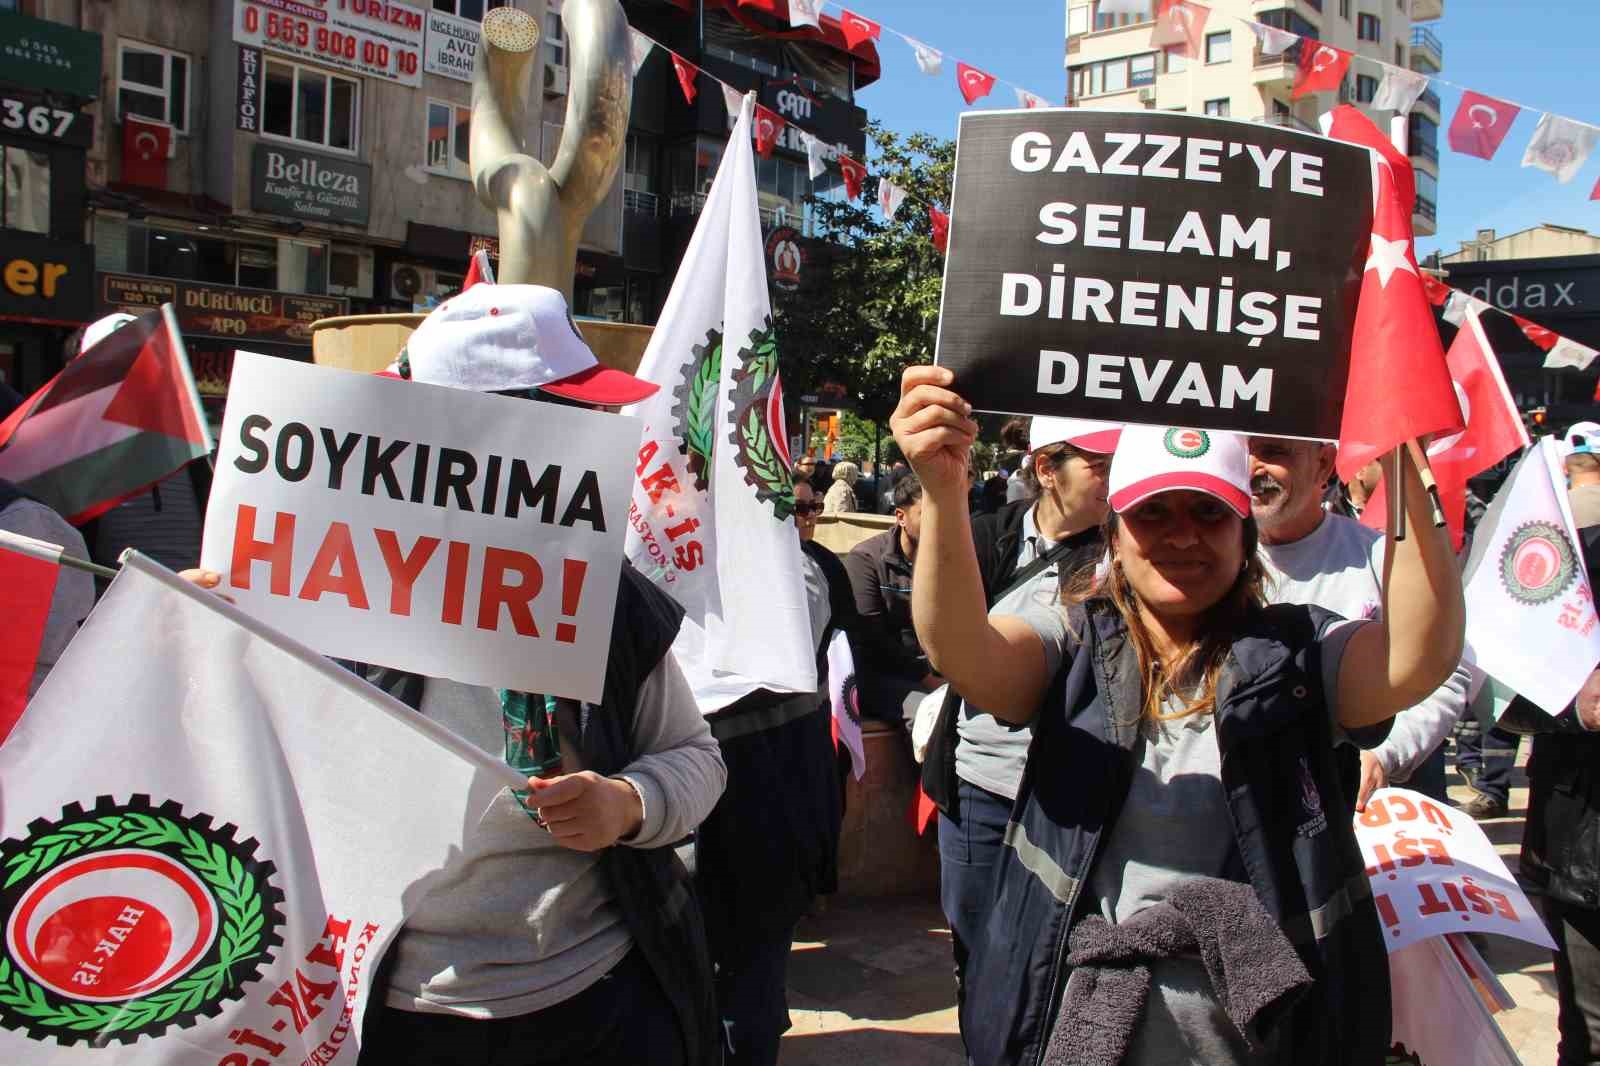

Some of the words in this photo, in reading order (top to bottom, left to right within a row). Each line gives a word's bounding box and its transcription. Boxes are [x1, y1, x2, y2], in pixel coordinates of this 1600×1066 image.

[245, 5, 259, 33] 0
[265, 10, 309, 48] 553
[315, 26, 356, 60] 908
[363, 39, 389, 68] 00
[446, 38, 477, 57] AVU
[453, 24, 480, 43] HUKU
[240, 49, 257, 130] KUAFÖR
[265, 152, 359, 195] Belleza
[1010, 131, 1324, 197] GAZZE'YE
[1035, 202, 1292, 272] SELAM,
[185, 289, 273, 314] DÜRÜMCÜ
[1000, 263, 1322, 347] DİRENİŞE
[1470, 277, 1576, 309] ddax
[210, 317, 247, 335] APO
[1036, 349, 1273, 412] DEVAM
[233, 414, 608, 532] SOYKIRIMA
[634, 424, 704, 573] AK-İŞ
[230, 503, 588, 644] HAYIR!
[1359, 795, 1453, 836] ÜCR
[1364, 830, 1455, 881] EŞİ
[1374, 893, 1401, 938] İ
[1416, 874, 1521, 922] EŞİT
